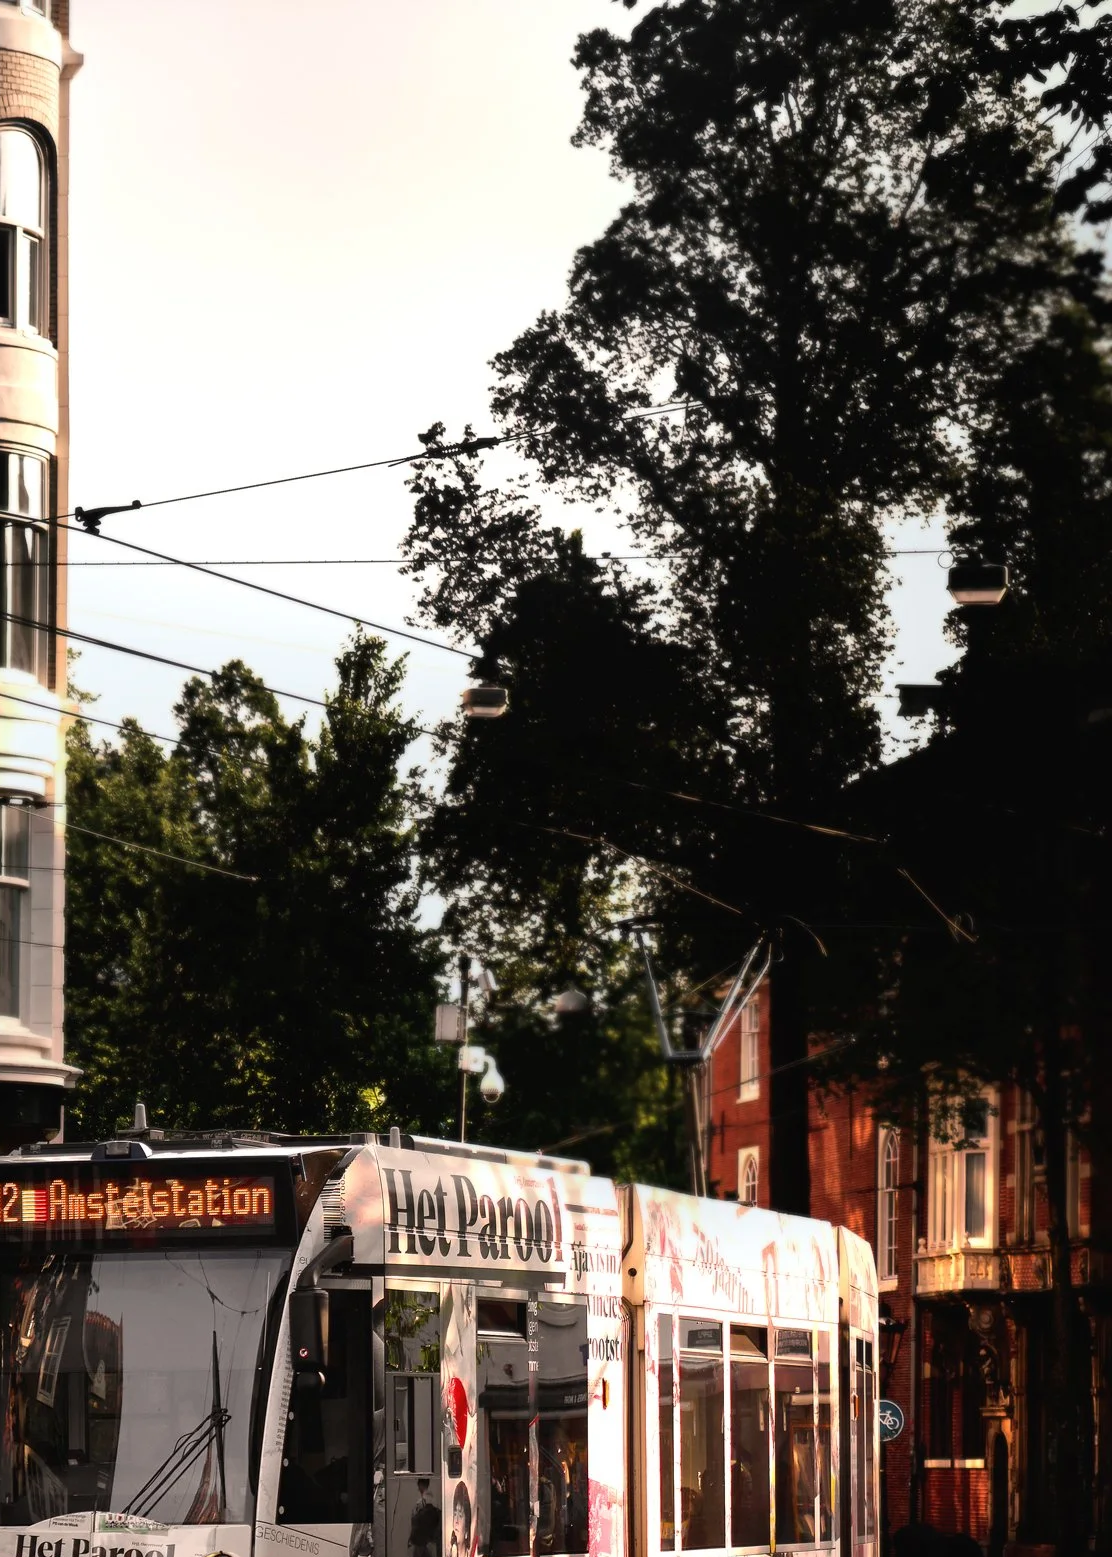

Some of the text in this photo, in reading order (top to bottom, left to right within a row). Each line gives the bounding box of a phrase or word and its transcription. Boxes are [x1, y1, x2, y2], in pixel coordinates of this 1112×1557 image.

[48, 1179, 272, 1221] Amstelstation
[381, 1167, 565, 1264] Het Parool
[255, 1525, 320, 1556] GESCHIEDENIS
